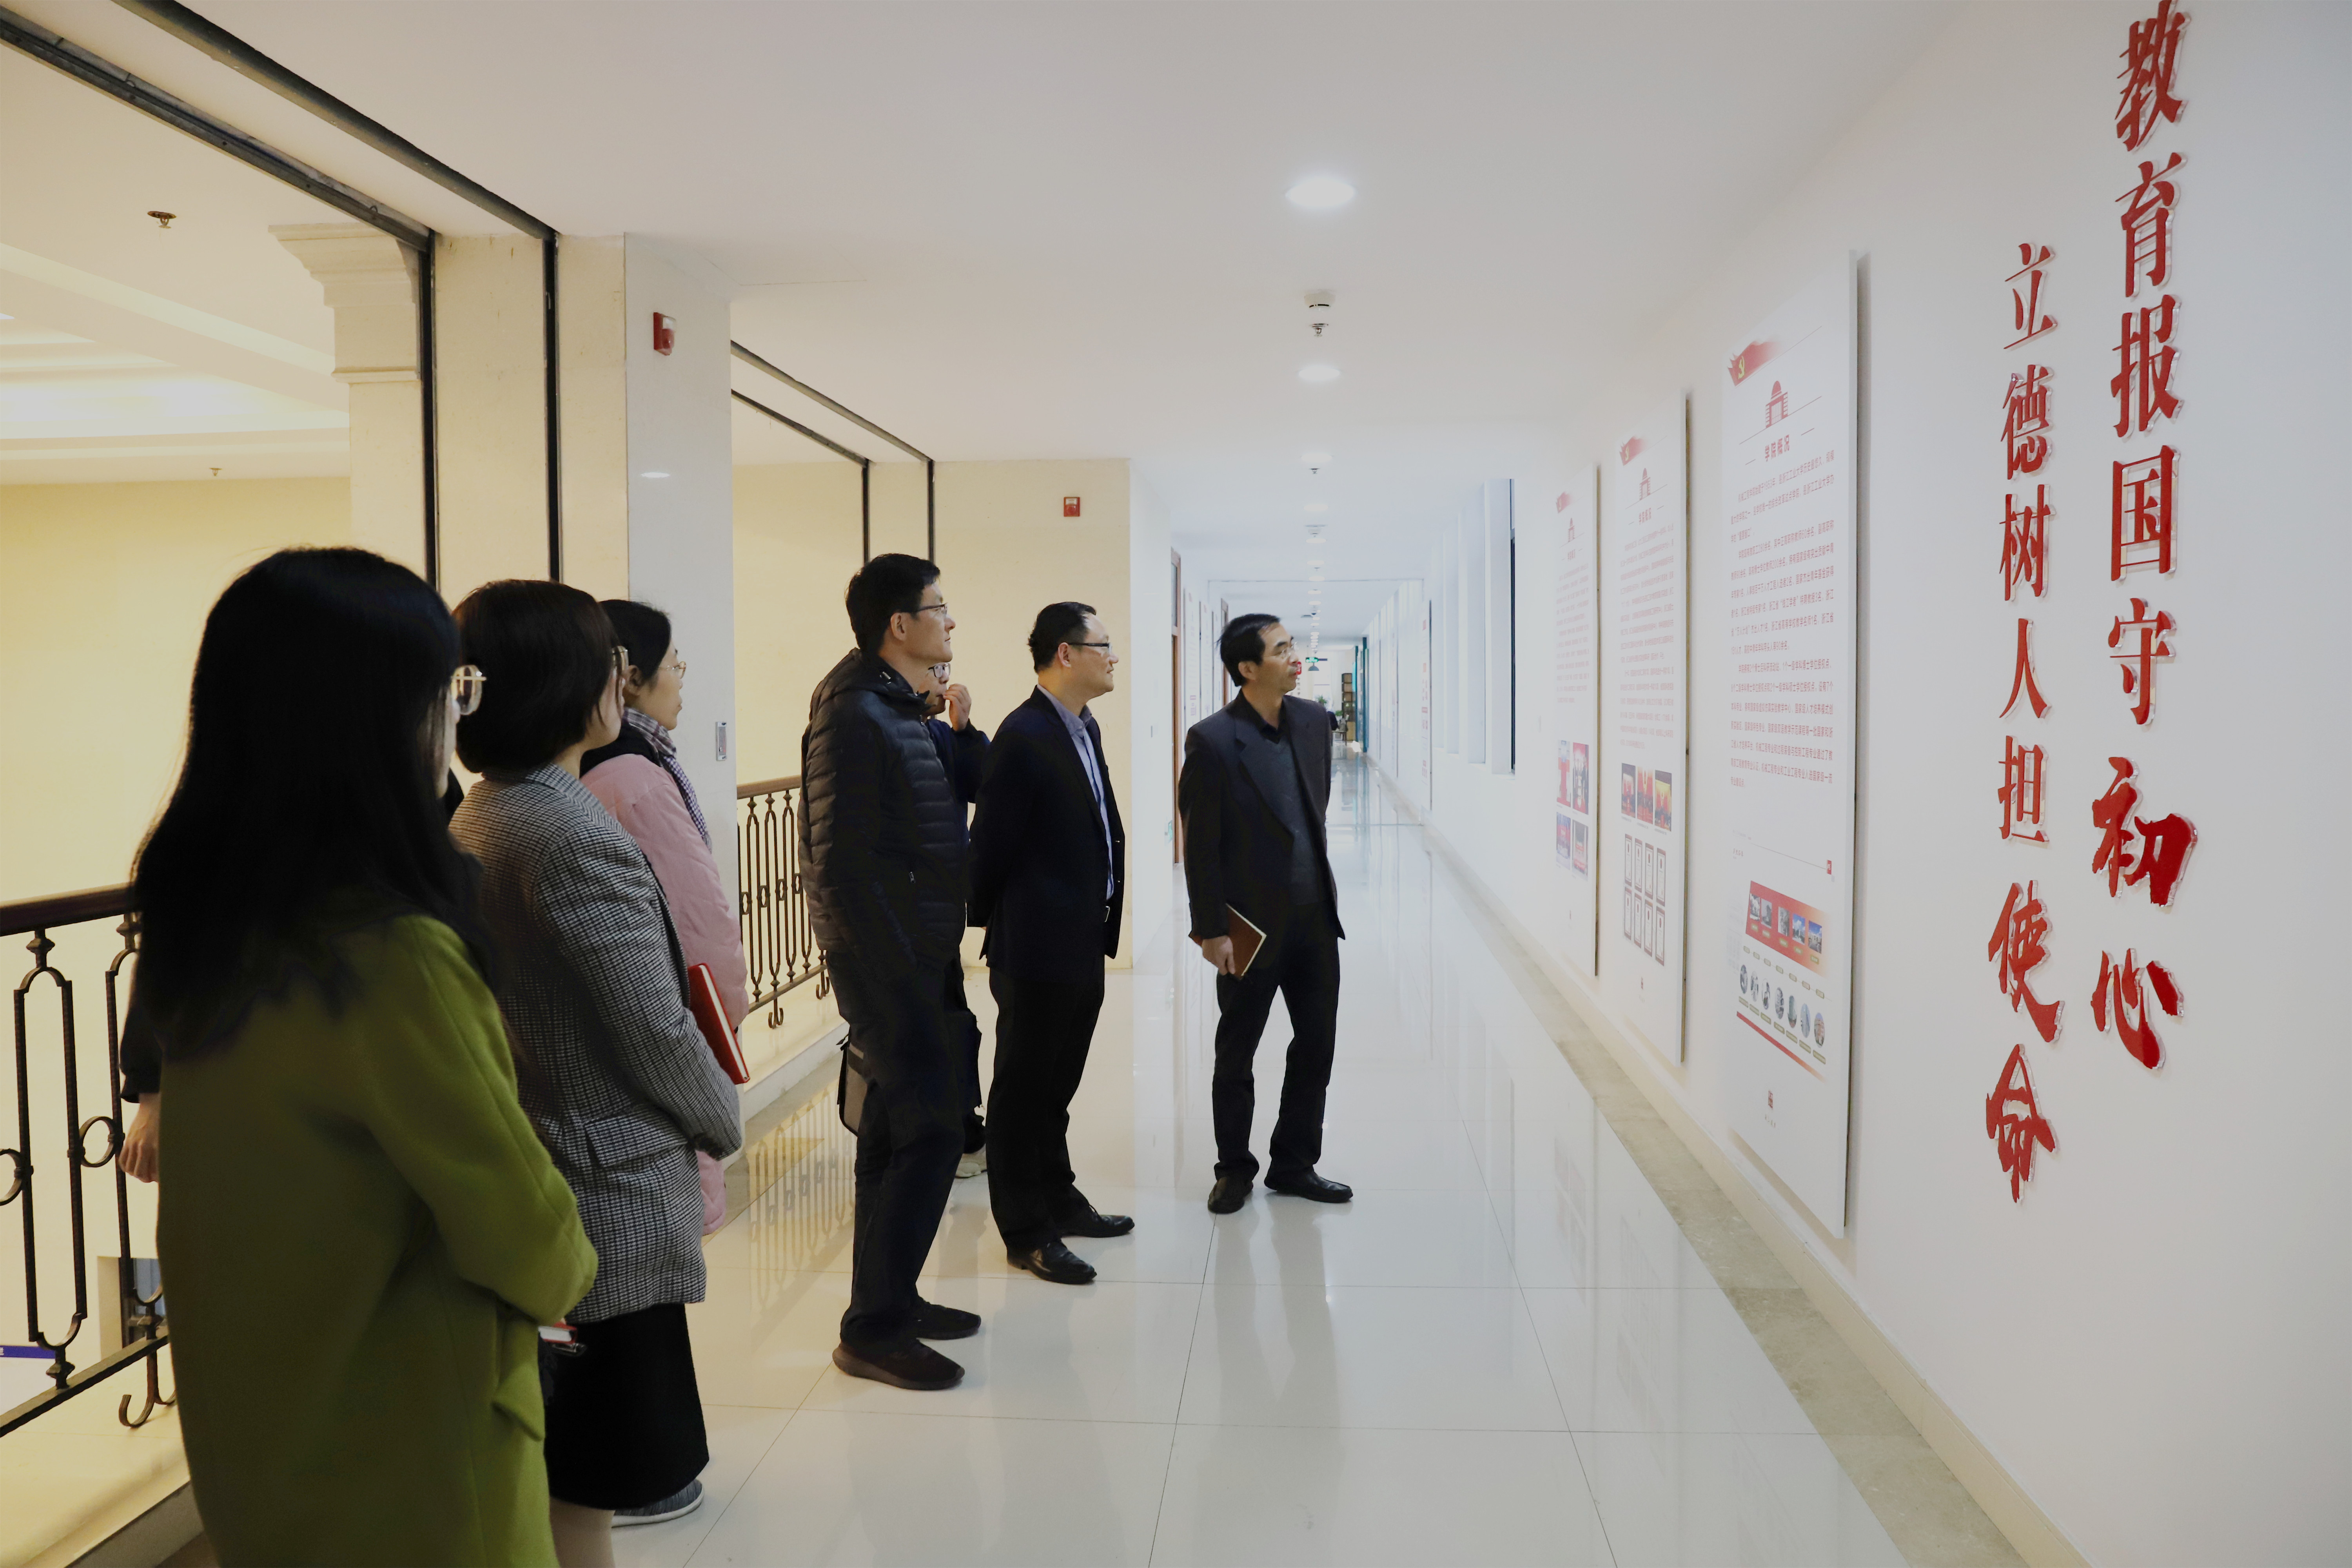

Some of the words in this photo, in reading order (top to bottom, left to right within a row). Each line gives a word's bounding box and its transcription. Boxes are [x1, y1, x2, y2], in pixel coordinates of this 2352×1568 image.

[1764, 434, 1790, 462] 学院概况
[1986, 243, 2063, 1203] 立德树人担使命
[2091, 0, 2196, 1069] 教育报国守初心
